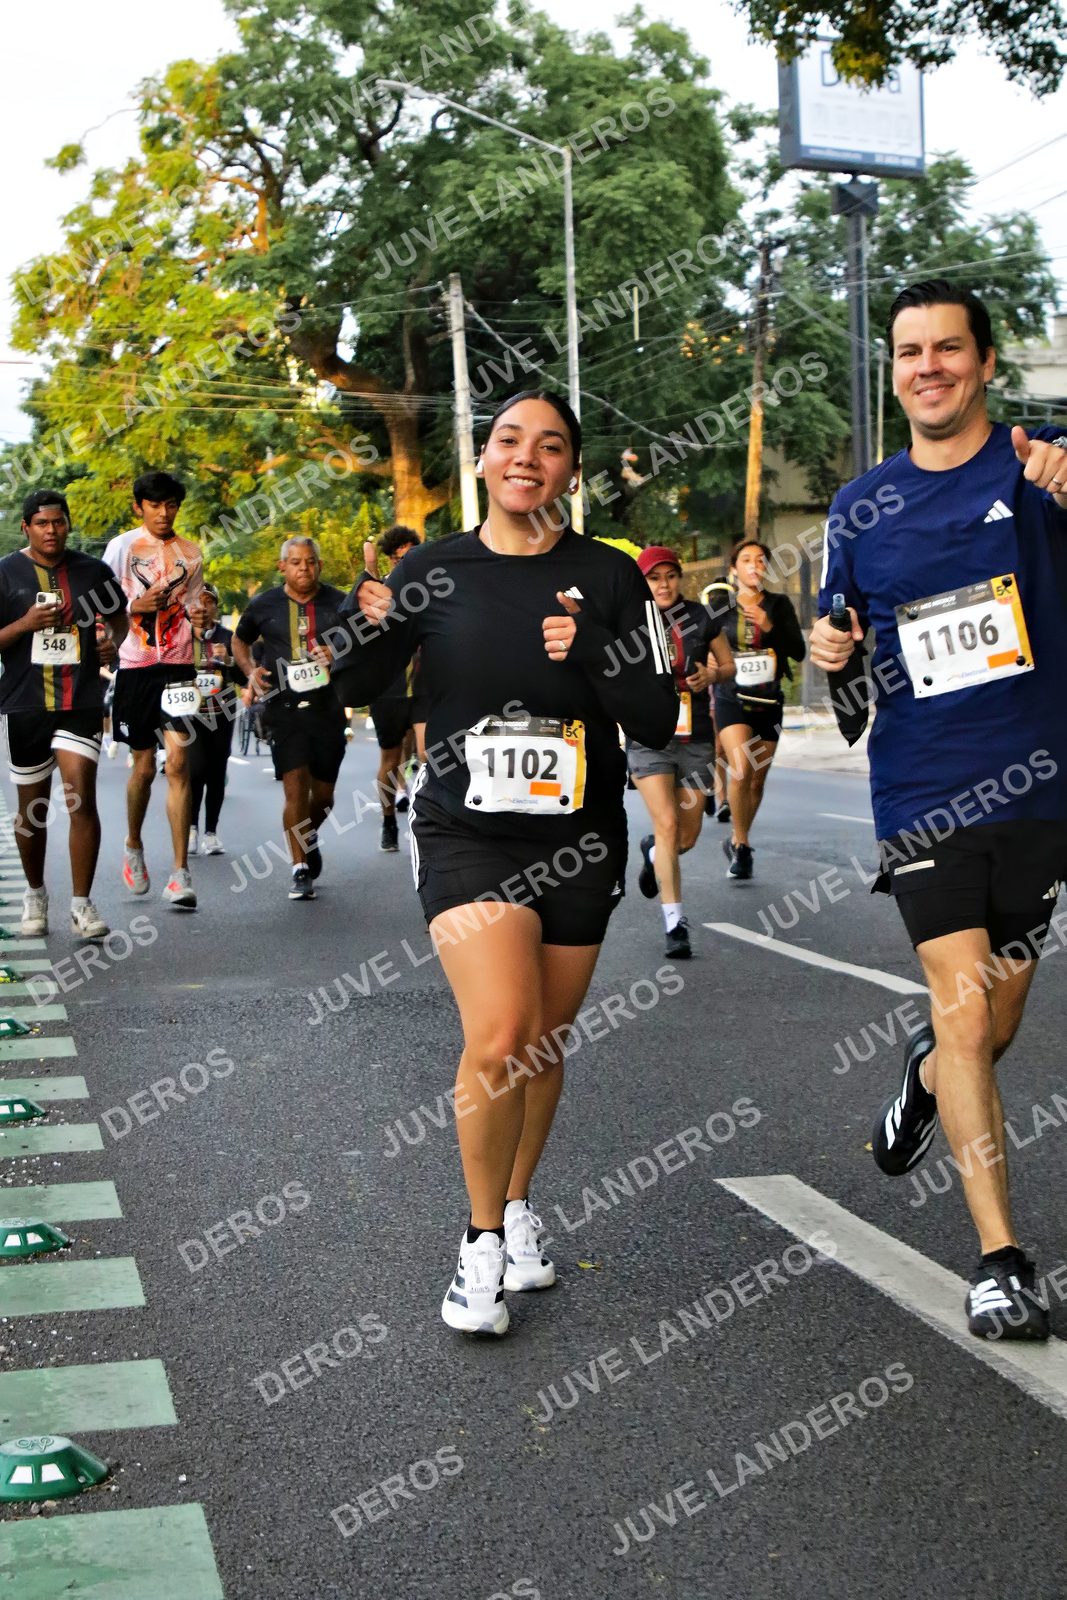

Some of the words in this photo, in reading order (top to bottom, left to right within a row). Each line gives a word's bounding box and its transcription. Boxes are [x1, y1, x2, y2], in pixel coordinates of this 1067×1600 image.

[918, 613, 999, 661] 1106
[43, 639, 66, 651] 548
[294, 665, 320, 680] 6015
[741, 660, 767, 673] 6231
[565, 727, 578, 738] 5K
[482, 748, 558, 780] 1102
